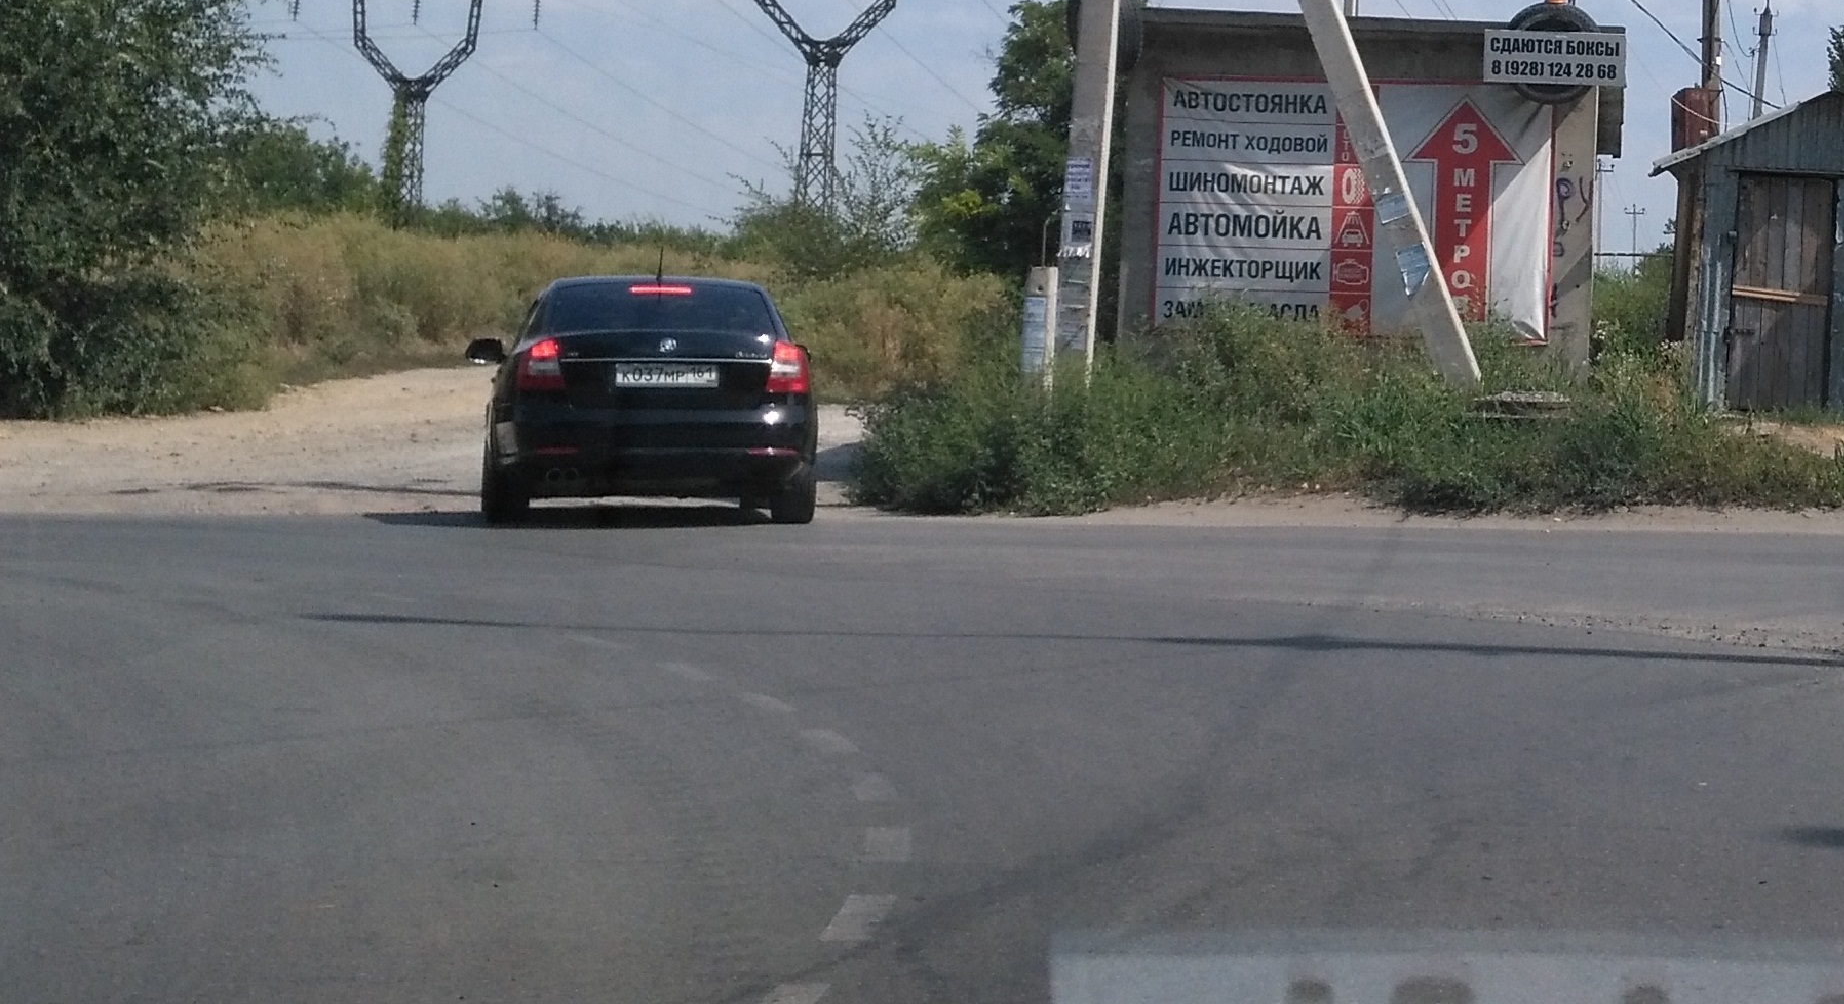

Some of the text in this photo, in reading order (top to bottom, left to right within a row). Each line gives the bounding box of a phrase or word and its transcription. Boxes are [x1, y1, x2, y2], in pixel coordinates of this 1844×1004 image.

[1490, 37, 1620, 57] СДАЮТСЯ БОКСЫ
[1491, 60, 1617, 80] 8 (928) 124 28 68
[1173, 90, 1327, 114] АВТОСТОЯНКА
[1171, 130, 1329, 154] РЕМОНТ ХОДОВОЙ
[1452, 123, 1478, 154] 5
[1169, 171, 1325, 196] ШИНОМОНТАЖ
[1167, 210, 1321, 240] АВТОМОЙКА
[1452, 168, 1476, 315] МЕТРОВ
[1165, 257, 1322, 283] ИНЖЕКТОРЩИК
